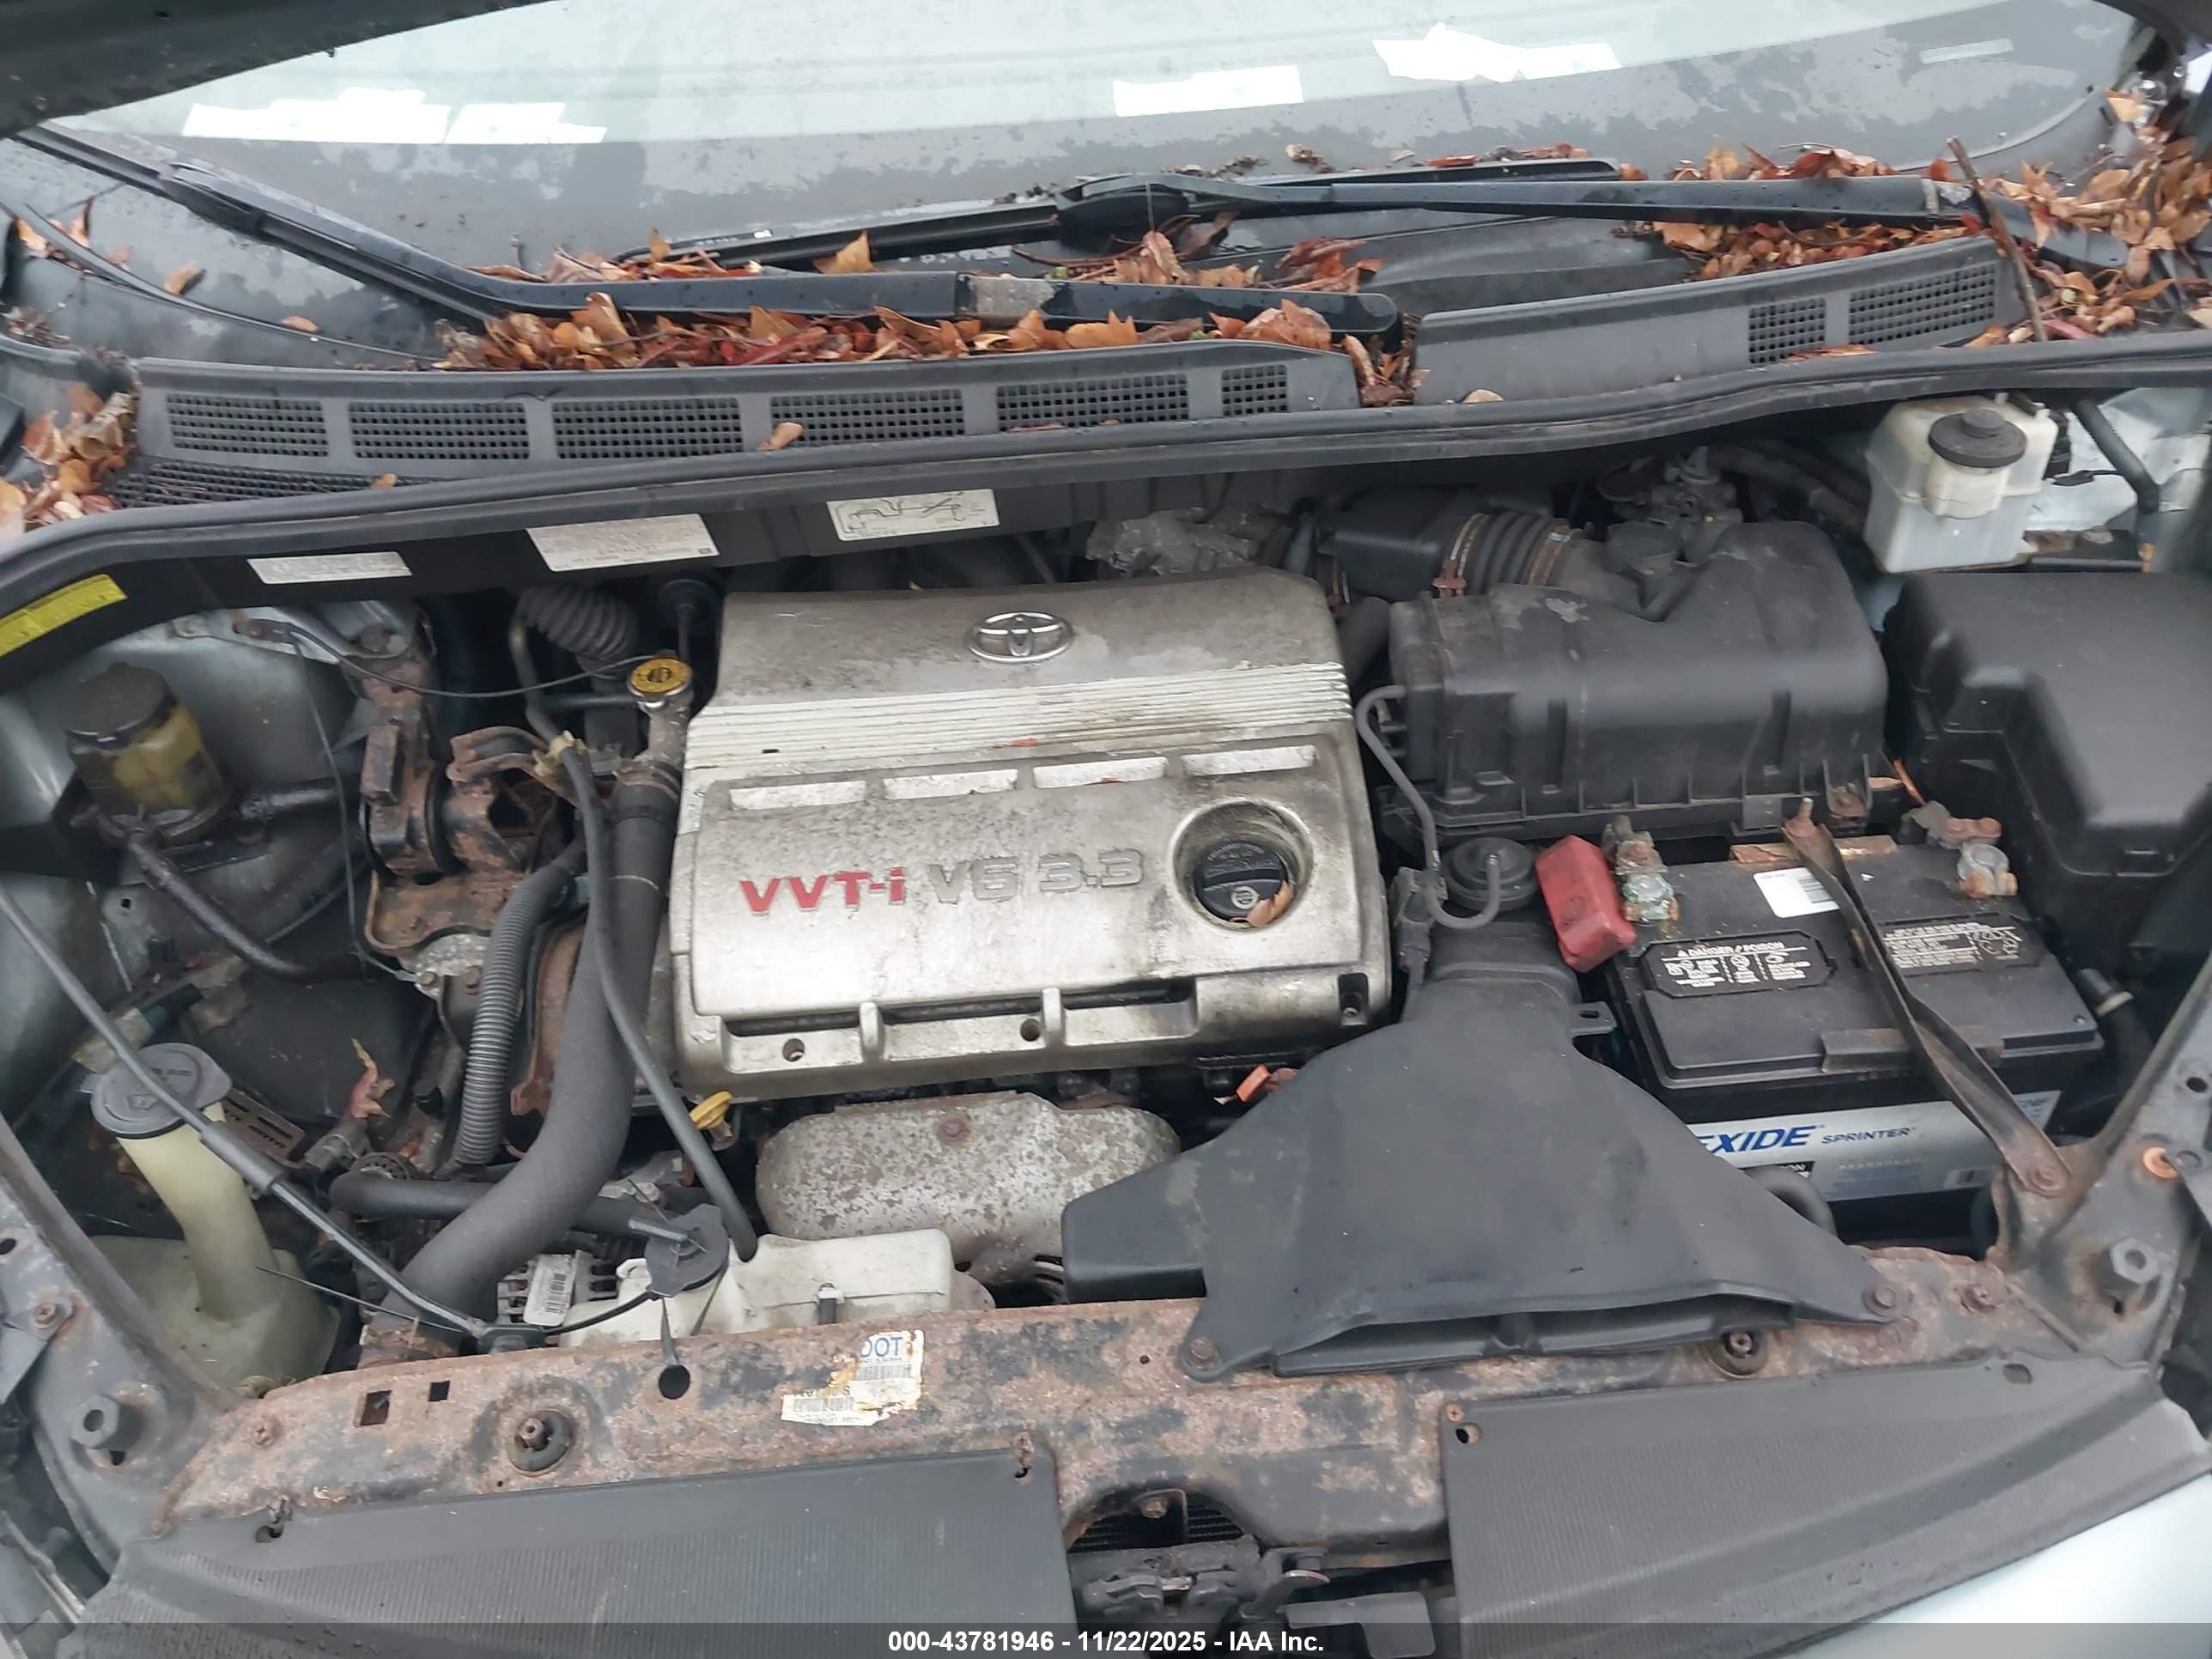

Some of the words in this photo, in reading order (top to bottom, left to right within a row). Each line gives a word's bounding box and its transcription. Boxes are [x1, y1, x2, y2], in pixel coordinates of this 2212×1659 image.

[738, 866, 905, 915] VVT-i
[927, 856, 1021, 905] V6
[1037, 847, 1144, 893] 3.3
[1821, 1127, 1911, 1145] SPRINTER
